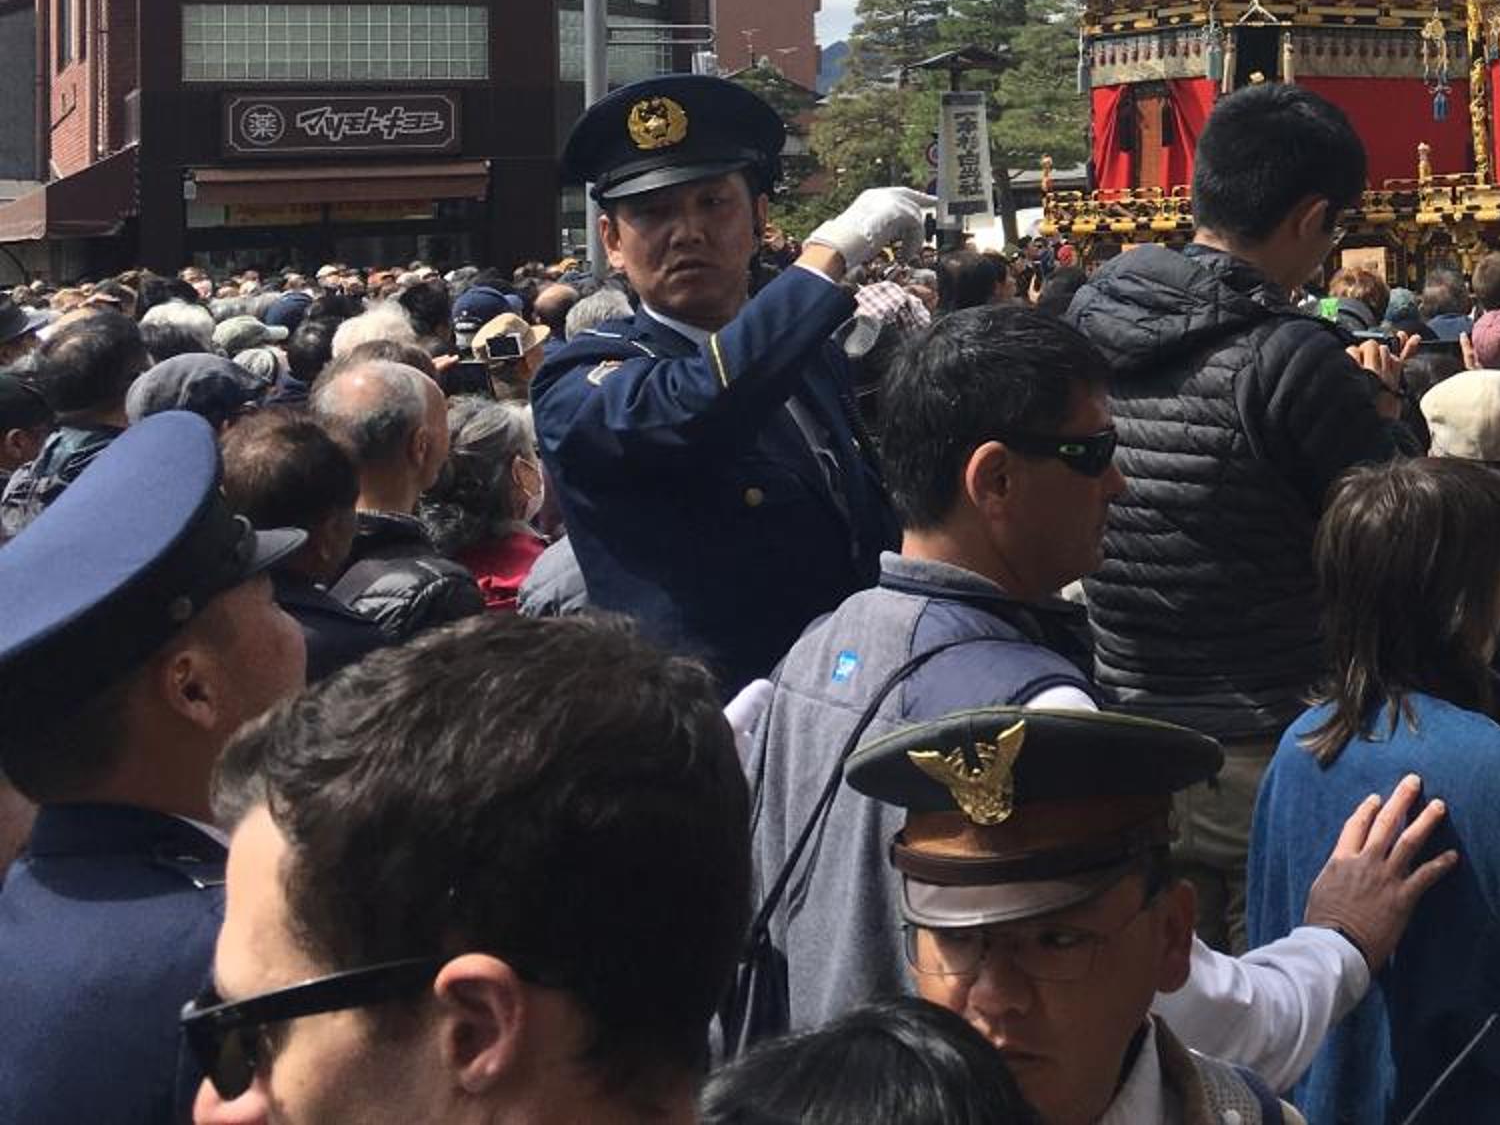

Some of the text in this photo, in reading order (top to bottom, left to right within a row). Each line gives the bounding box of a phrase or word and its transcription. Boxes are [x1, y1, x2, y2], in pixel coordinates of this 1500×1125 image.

[245, 106, 444, 141] 薬 マツモトキヨシ
